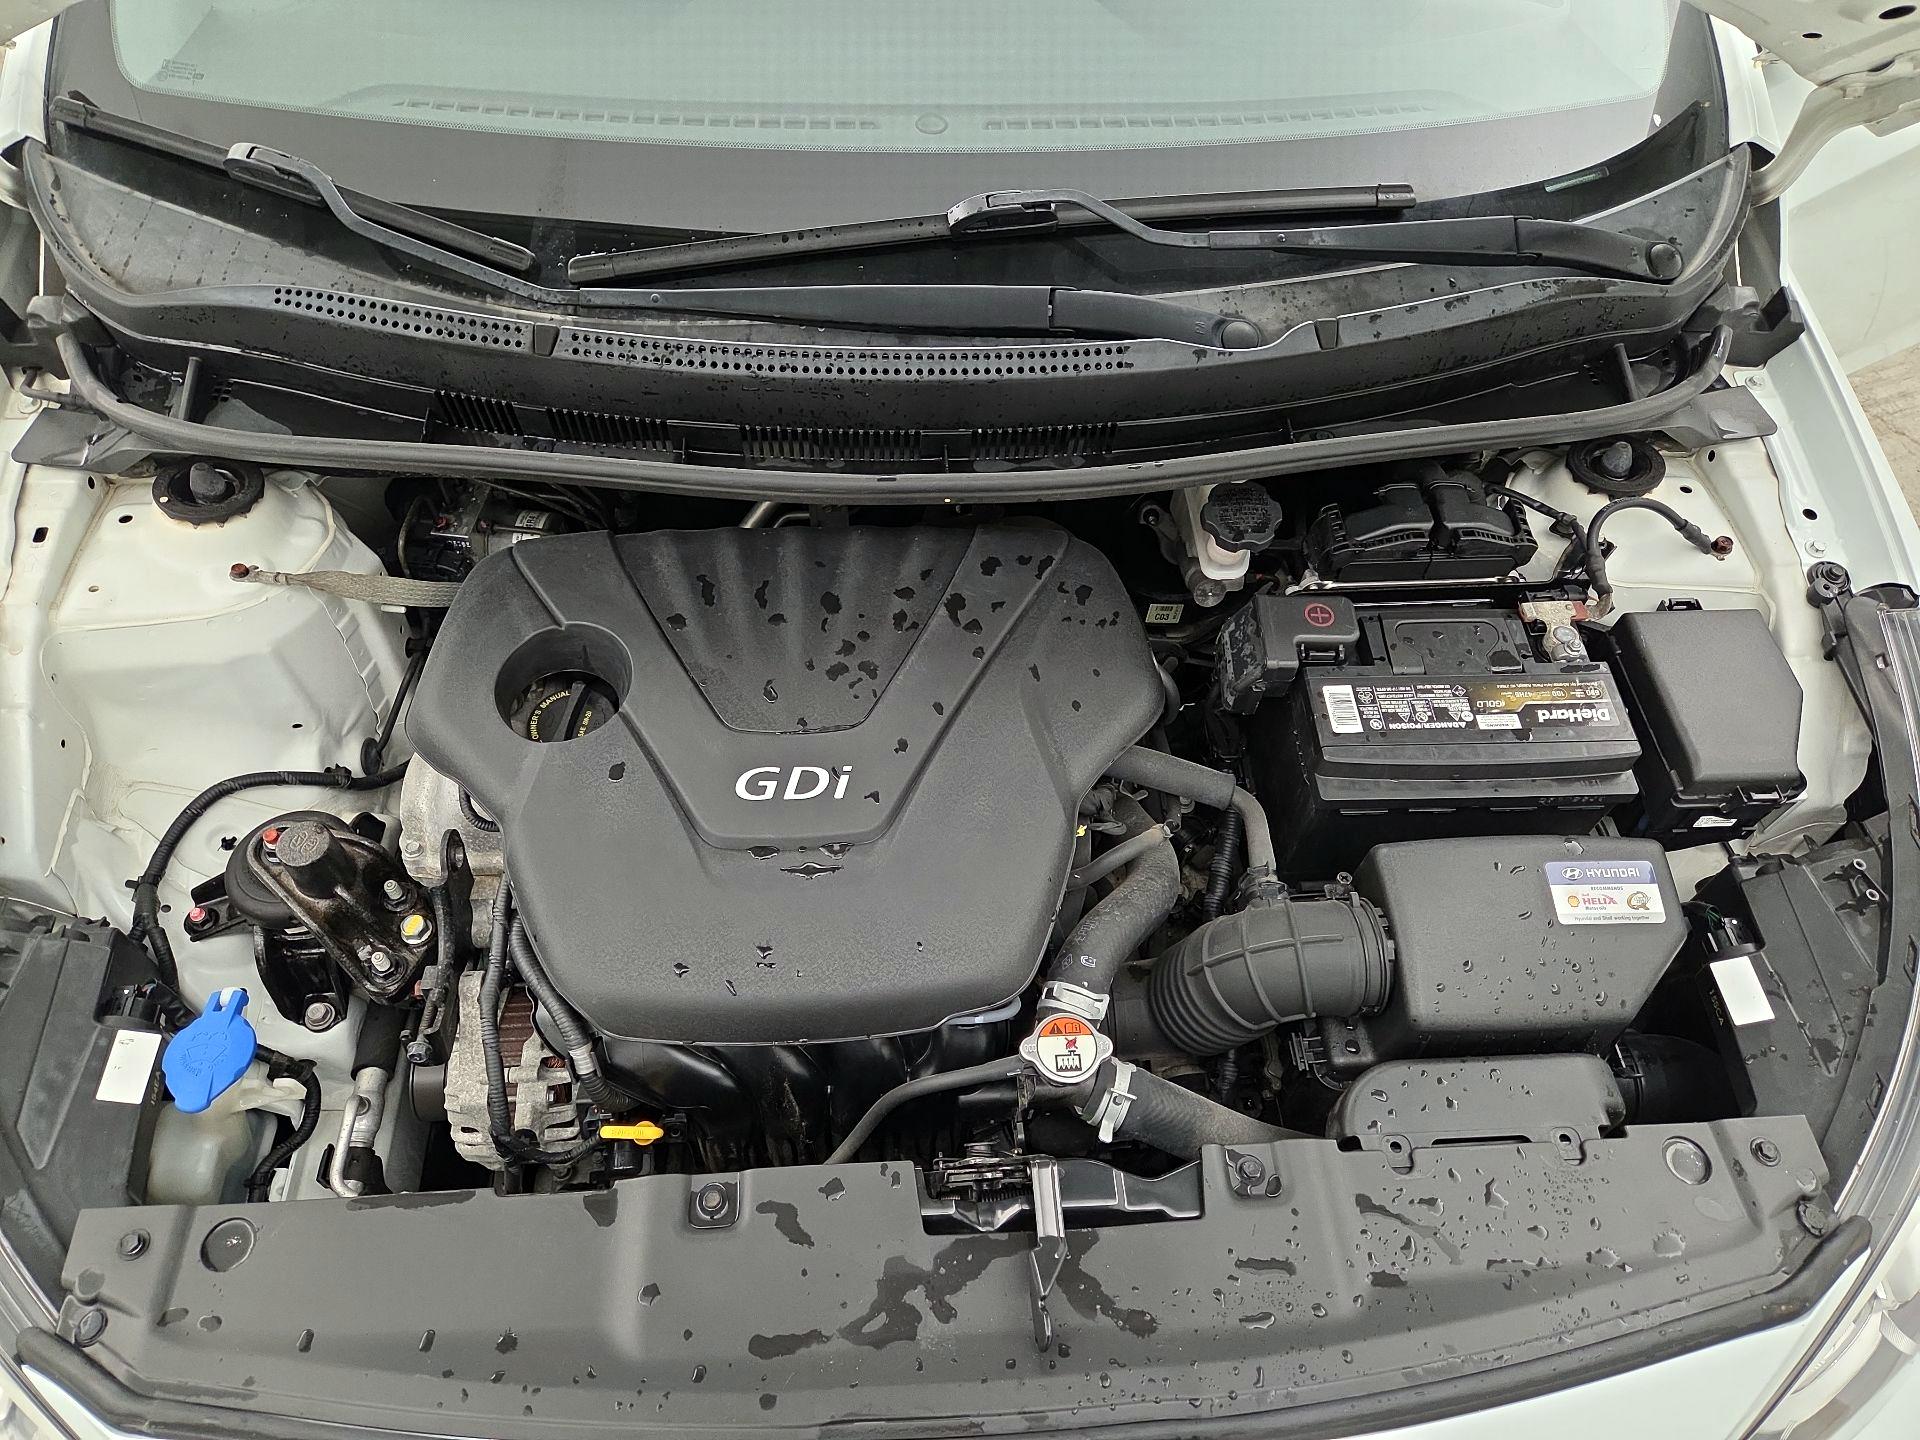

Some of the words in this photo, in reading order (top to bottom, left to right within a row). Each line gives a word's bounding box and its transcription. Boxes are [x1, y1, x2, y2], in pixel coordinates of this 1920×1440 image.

[1154, 613, 1170, 621] C03
[1477, 700, 1502, 708] GOLD
[529, 709, 542, 740] OWNER'S
[539, 690, 572, 709] MANUAL
[1537, 708, 1611, 723] DieHard
[577, 724, 587, 737] SAE
[1389, 722, 1460, 731] DANGER/POISON
[734, 765, 853, 801] GDi
[1585, 867, 1640, 878] HYUNDAI
[1582, 895, 1618, 905] HELIX
